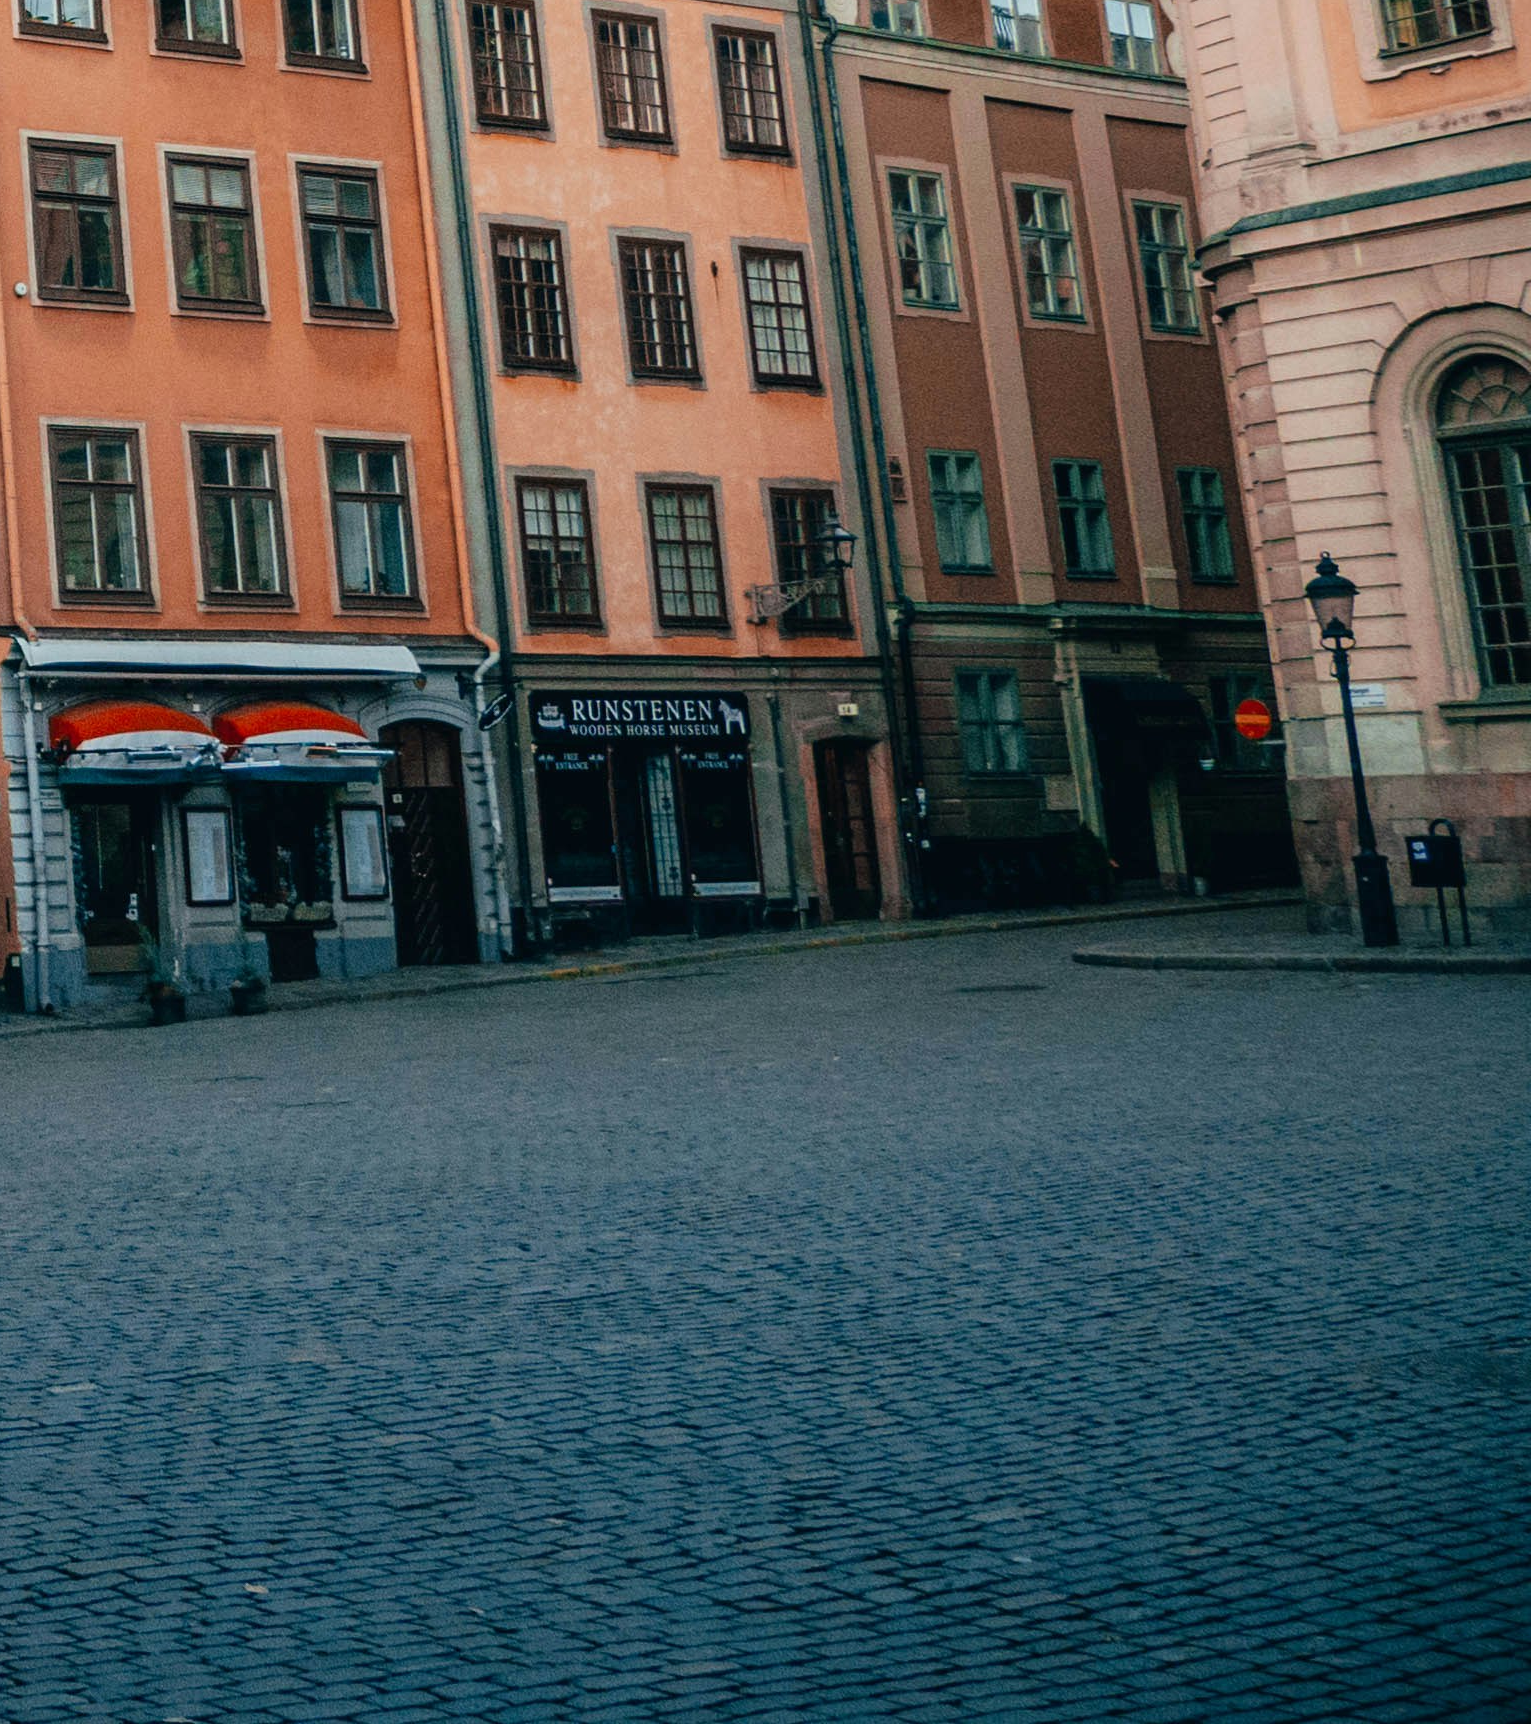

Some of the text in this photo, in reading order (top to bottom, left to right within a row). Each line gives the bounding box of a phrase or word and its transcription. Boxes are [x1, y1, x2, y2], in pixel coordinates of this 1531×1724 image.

[570, 699, 713, 722] RUNSTENEN
[569, 724, 720, 737] WOODEN HORSE MUSEUM
